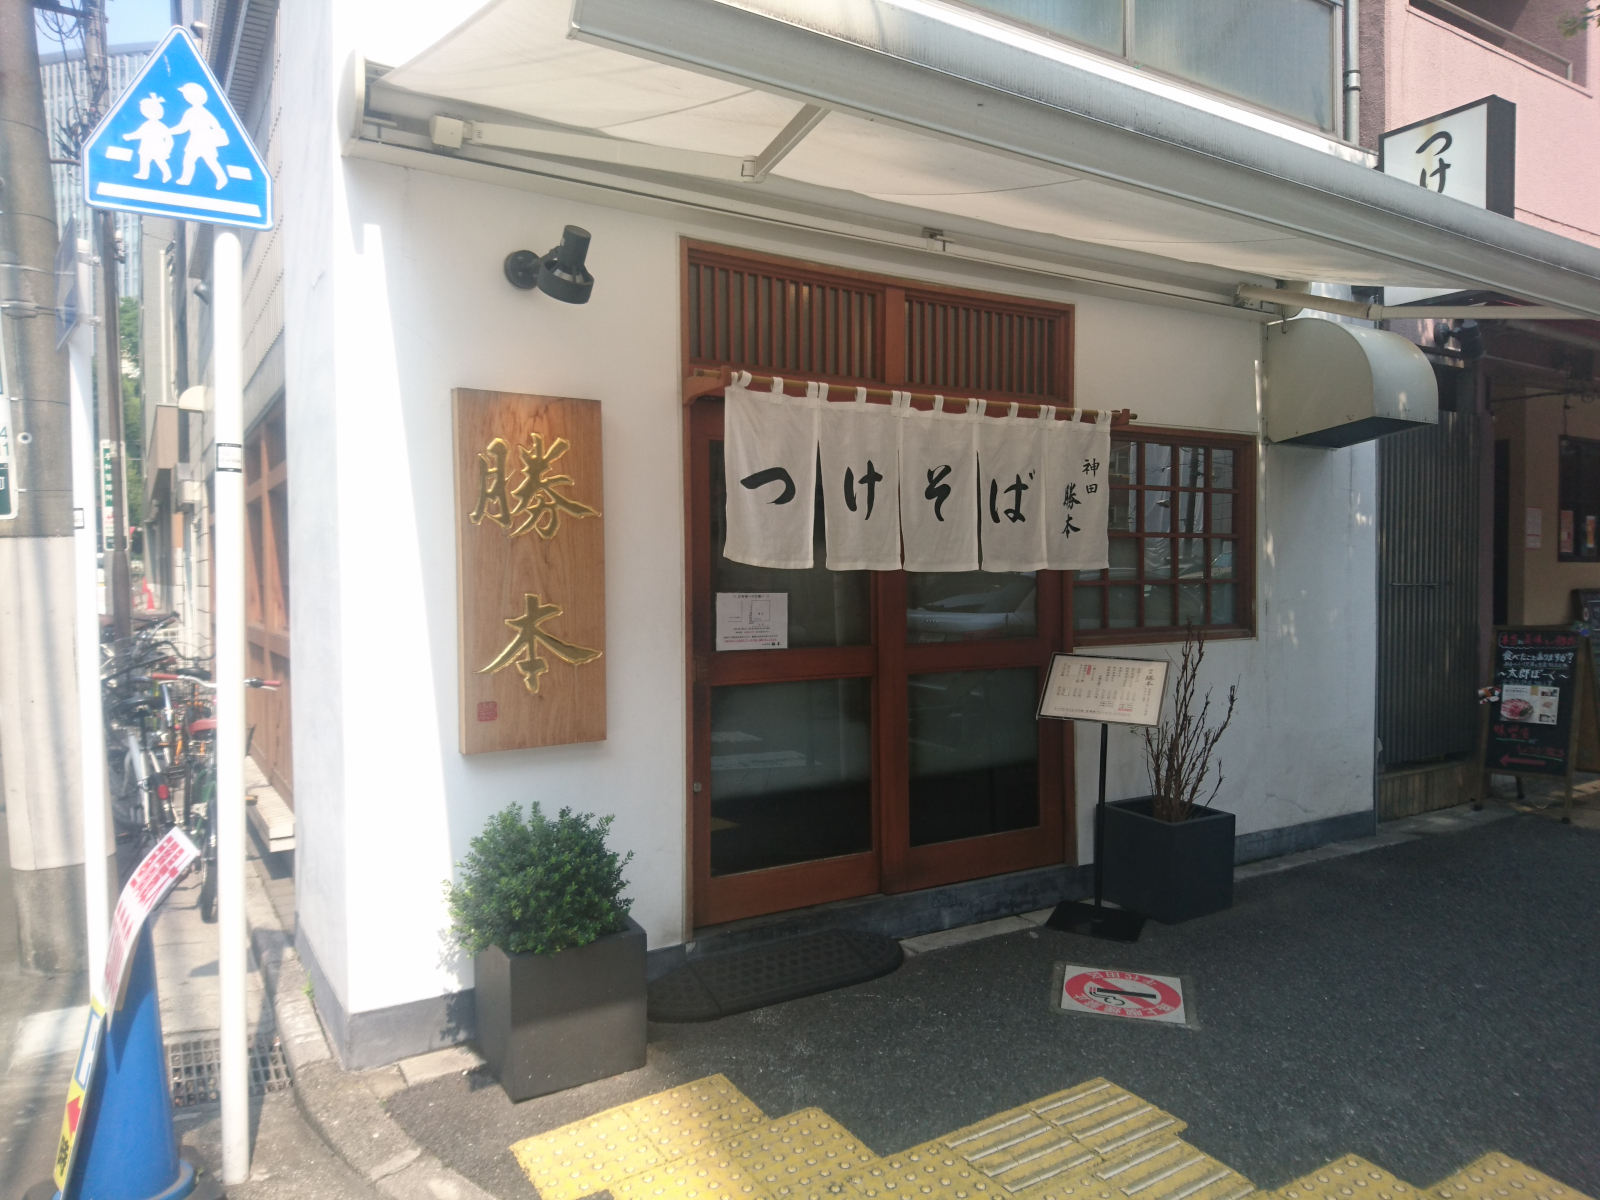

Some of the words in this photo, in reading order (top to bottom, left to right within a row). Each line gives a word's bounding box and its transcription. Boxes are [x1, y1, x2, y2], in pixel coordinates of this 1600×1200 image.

[1415, 131, 1452, 193] つけ
[740, 460, 1036, 523] つけそば
[1082, 458, 1100, 495] 神田
[1061, 483, 1082, 538] 勝本
[469, 432, 602, 694] 勝本
[1074, 994, 1175, 1016] 路上喫煙禁止
[1086, 970, 1157, 986] 千代田区
